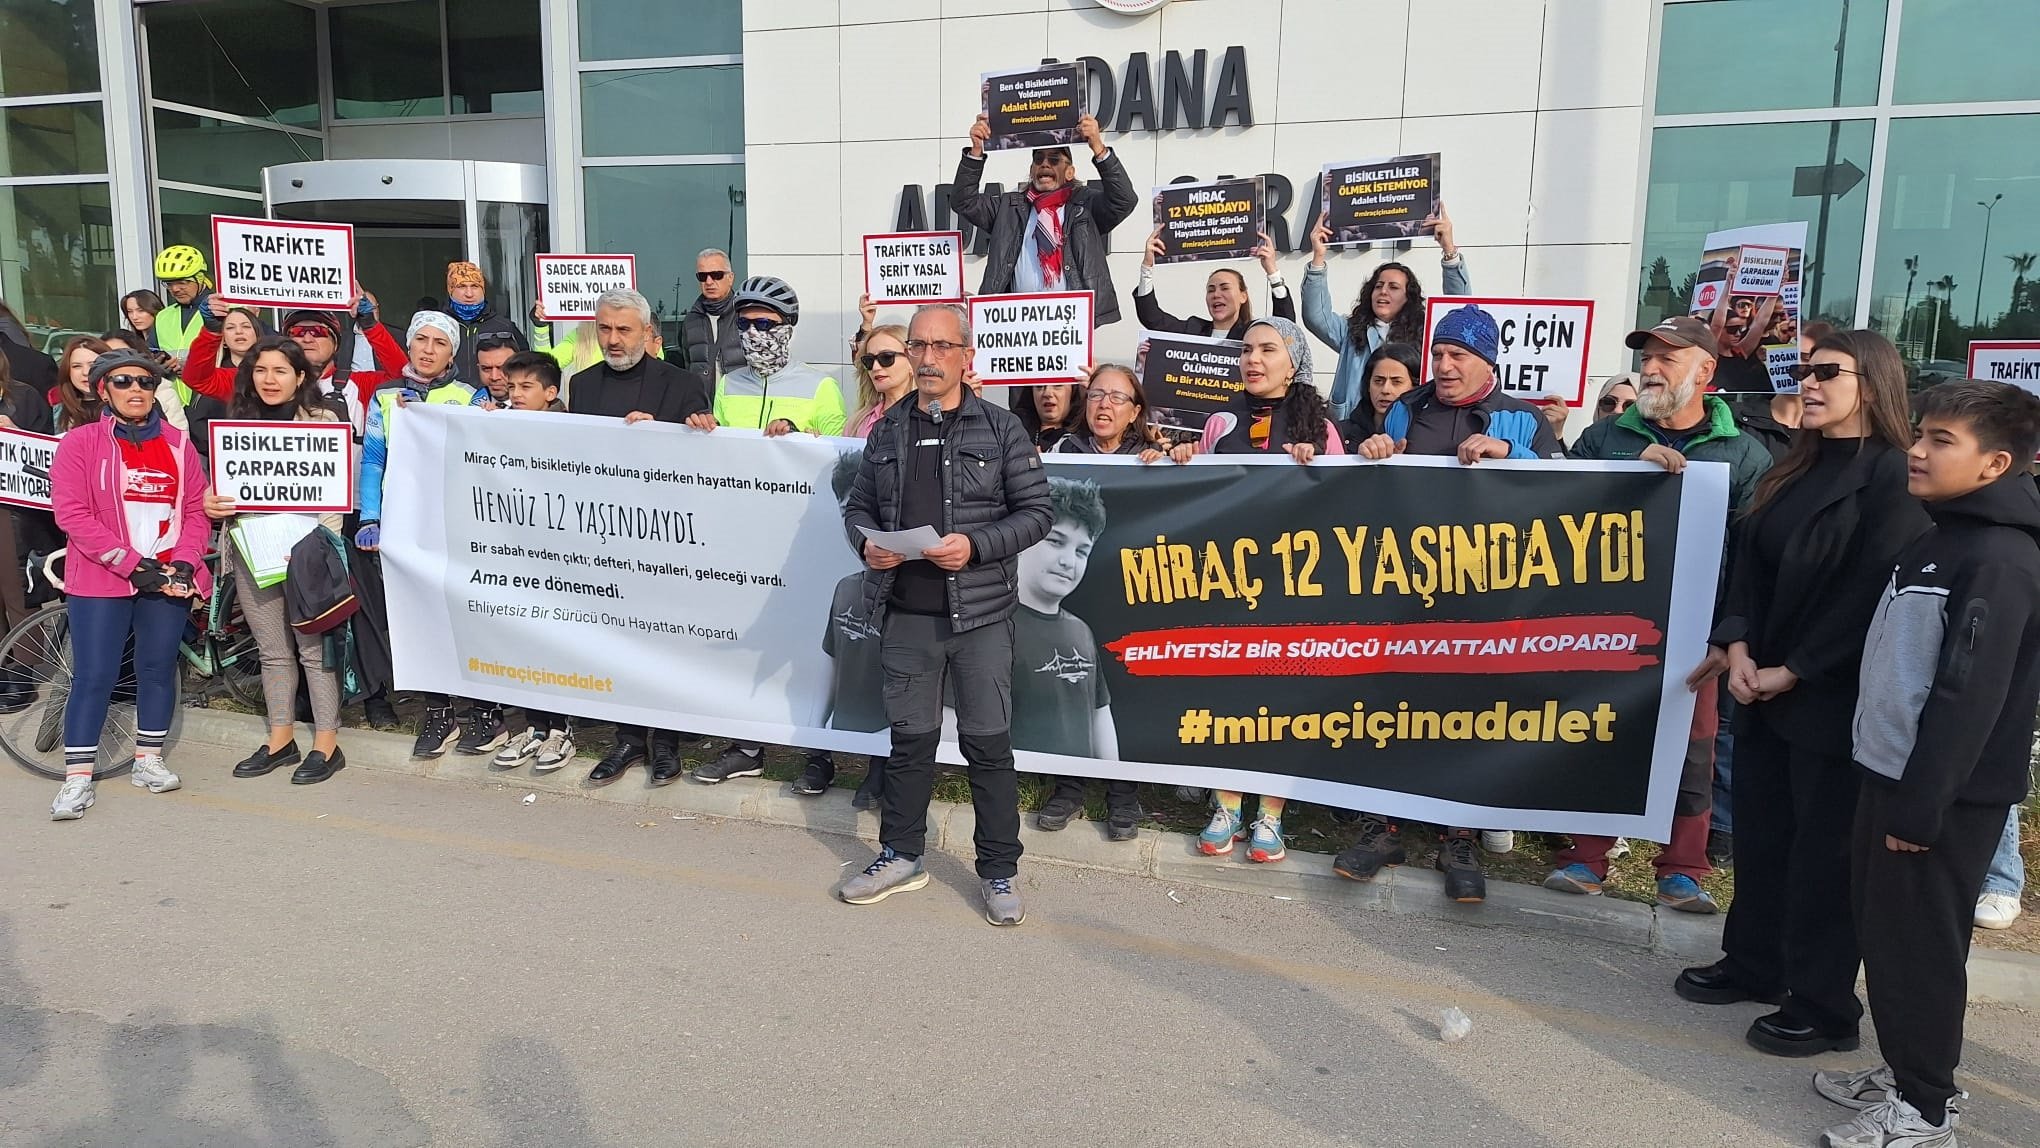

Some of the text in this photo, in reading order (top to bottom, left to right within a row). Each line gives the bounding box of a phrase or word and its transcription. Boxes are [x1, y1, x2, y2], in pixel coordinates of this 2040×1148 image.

[1000, 77, 1068, 92] Ben de Bisikletimle
[1041, 46, 1254, 132] DANA
[1018, 90, 1051, 99] Yoldayım
[1001, 99, 1070, 113] Adalet İstiyorum
[1345, 167, 1419, 184] BİSİKLETLİLER
[1338, 179, 1428, 196] ÖLMEK İSTEMİYOR
[1189, 190, 1226, 205] MİRAÇ
[1351, 193, 1416, 206] Adalet İstiyoruz
[1168, 200, 1250, 218] 12 YAŞINDAYDI
[1354, 208, 1408, 218] #miraçiçinadalet
[1169, 215, 1249, 230] Ehliyetsiz Bir Sürücü
[1174, 226, 1244, 239] Hayattan Kopardı
[242, 233, 325, 256] TRAFİKTE
[874, 241, 950, 258] TRAFİKTE SAĞ
[1182, 238, 1236, 249] #miraçiçinadalet
[228, 258, 342, 285] BİZ DE VARIZ!
[546, 264, 626, 276] SADECE ARABA
[880, 262, 947, 280] ŞERİT YASAL
[230, 284, 343, 300] BİSİKLETLİYİ FARK ET!
[548, 280, 582, 294] SENİN.
[886, 283, 942, 296] HAKKIMIZ!
[984, 305, 1076, 325] YOLU PAYLAŞ!
[978, 326, 1083, 349] KORNAYA DEĞİL
[1523, 313, 1575, 355] İÇİN
[1166, 349, 1200, 362] OKULA
[991, 356, 1067, 373] FRENE BAS!
[1182, 362, 1230, 377] ÖLÜNMEZ
[1166, 374, 1178, 383] Bu
[1180, 375, 1193, 385] Bir
[1195, 378, 1220, 388] KAZA
[1176, 389, 1230, 402] #miraçiçinadalet
[222, 432, 339, 452] BİSİKLETİME
[226, 460, 336, 480] ÇARPARSAN
[464, 452, 816, 495] Miraç Çam, bisikletiyle okuluna giderken hayattan koparıldı.
[240, 482, 322, 502] ÖLÜRÜM!
[473, 486, 705, 546] HENÜZ 12 YAŞINDAYDI.
[471, 542, 786, 588] Bir sabah evden çıktı; defteri, hayalleri, geleceği vardı.
[1120, 510, 1645, 610] MİRAÇ 12 YAŞINDAYDI
[470, 569, 625, 599] Ama eve dönemedi.
[468, 600, 738, 641] Ehliyetsiz Bir Sürücü Onu Hayattan Kopardı
[1125, 633, 1638, 662] EHLİYETSİZ BİR SÜRÜCÜ HAYATTAN KOPARDI
[468, 657, 614, 693] #miraçiçinadalet
[1178, 700, 1617, 749] #miraçiçinadalet
